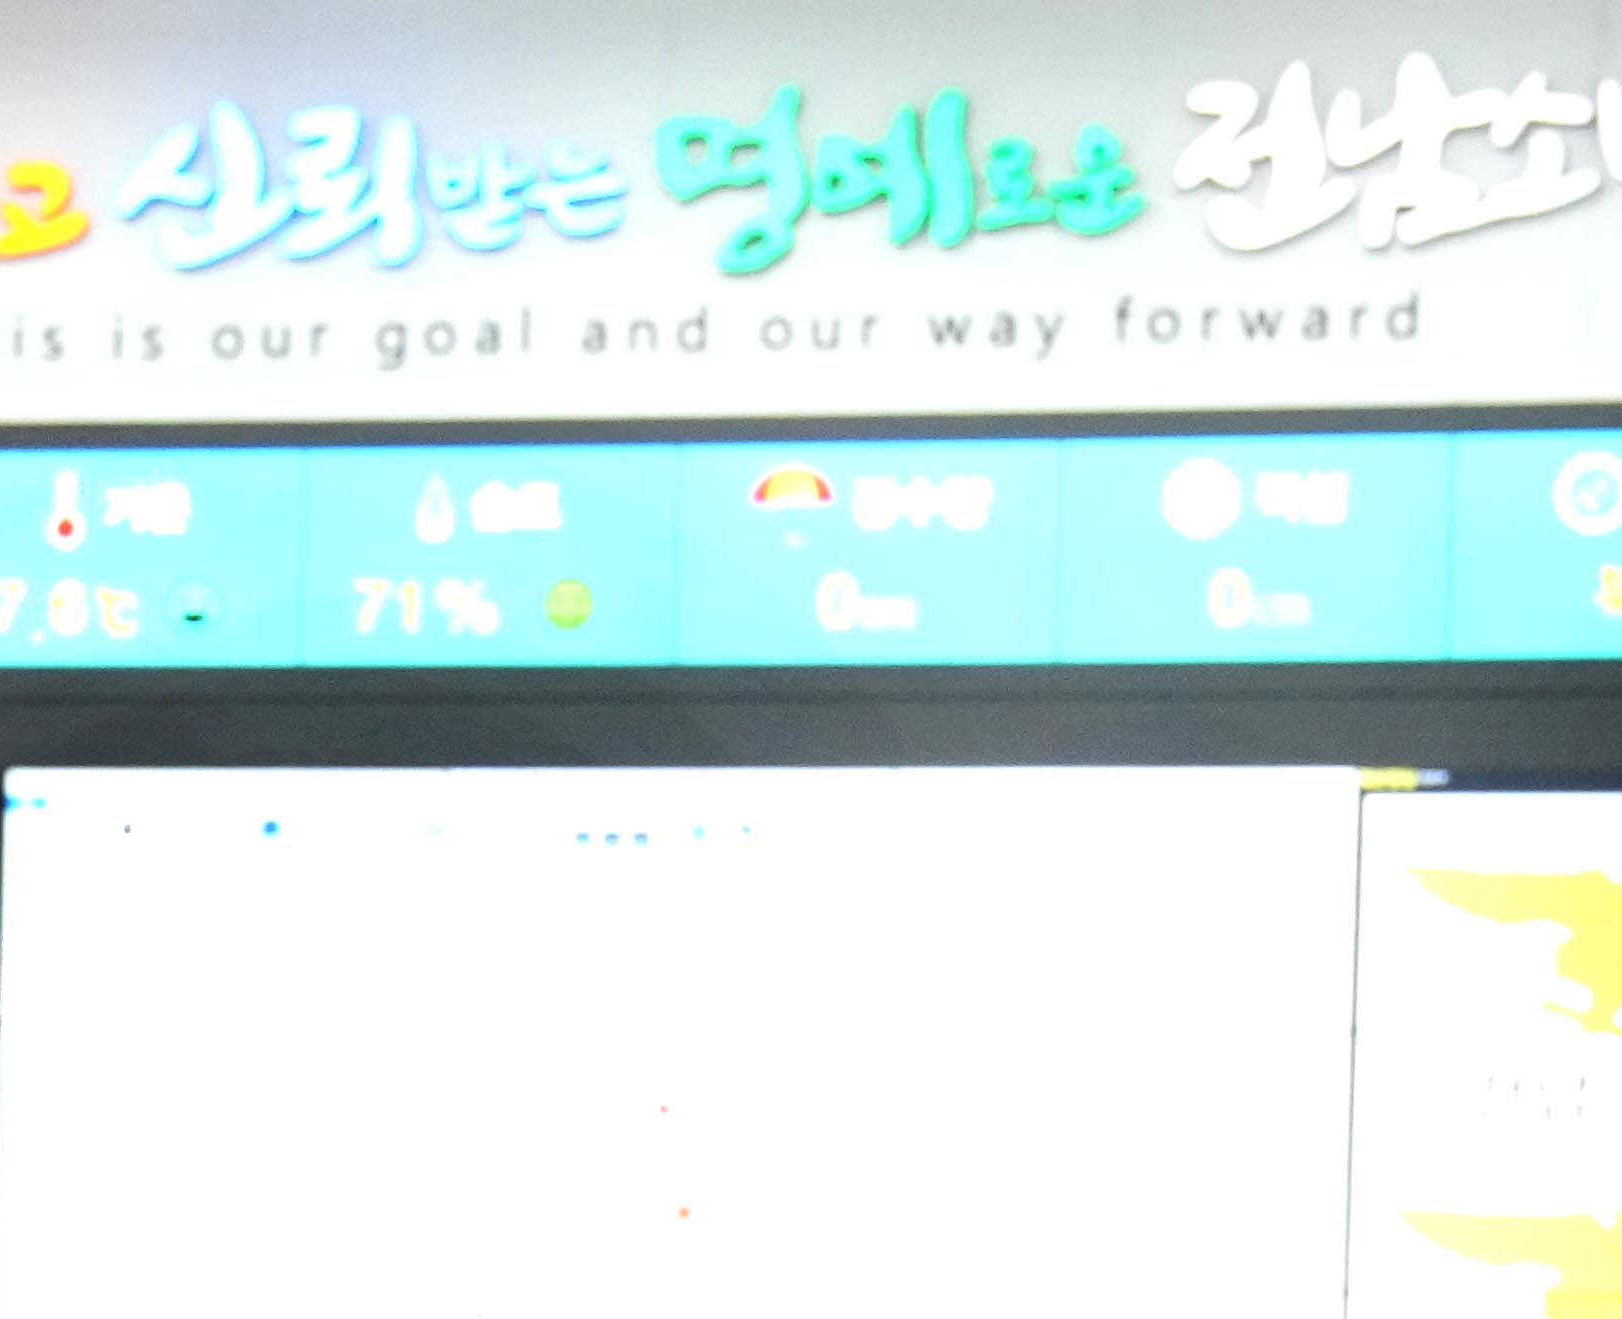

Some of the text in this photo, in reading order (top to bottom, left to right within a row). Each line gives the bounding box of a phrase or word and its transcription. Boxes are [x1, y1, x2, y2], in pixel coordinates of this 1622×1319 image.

[115, 98, 630, 270] 신뢰받는
[652, 83, 1149, 277] 명예로운
[112, 314, 163, 360] is
[212, 321, 327, 360] our
[376, 309, 530, 371] goal
[582, 307, 708, 354] and
[760, 313, 878, 350] our
[928, 311, 1063, 360] way
[1115, 294, 1420, 343] forward
[353, 578, 501, 636] 71%
